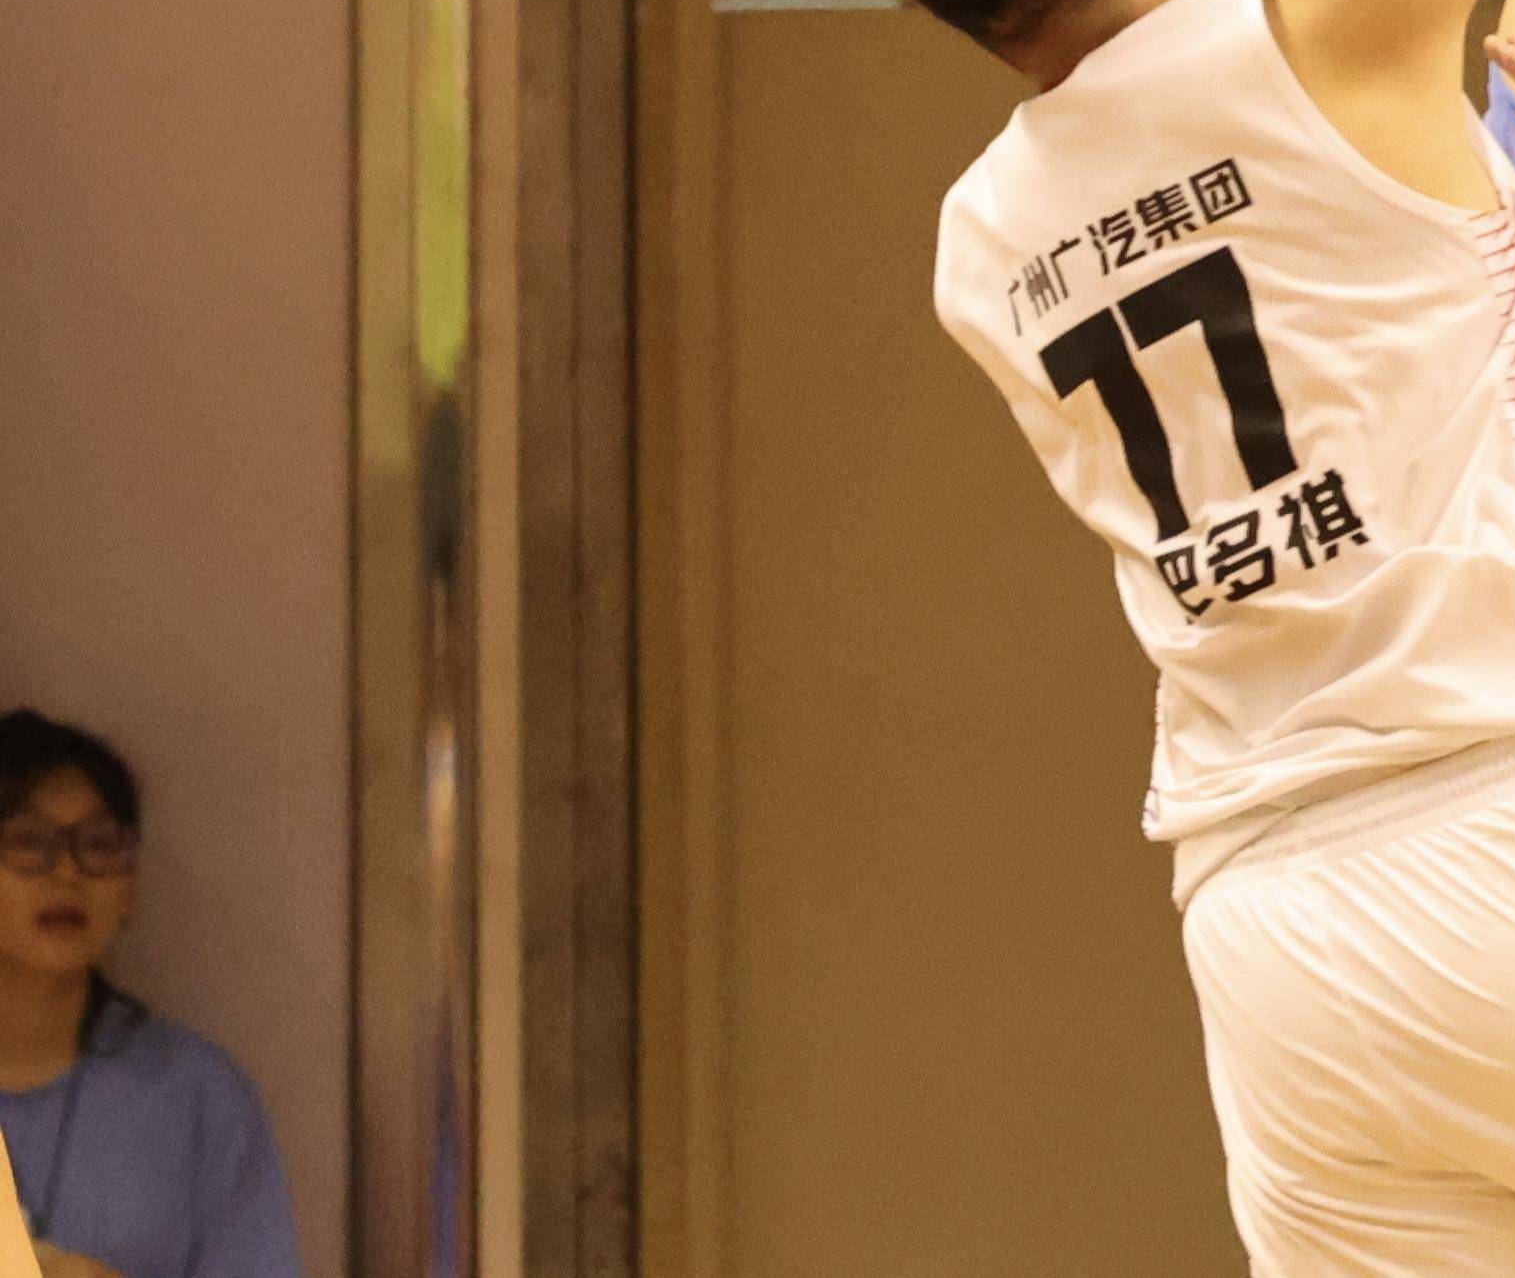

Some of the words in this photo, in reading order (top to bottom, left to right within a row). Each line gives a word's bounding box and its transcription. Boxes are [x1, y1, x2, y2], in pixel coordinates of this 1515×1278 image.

[1007, 157, 1253, 337] 广州广汽集团
